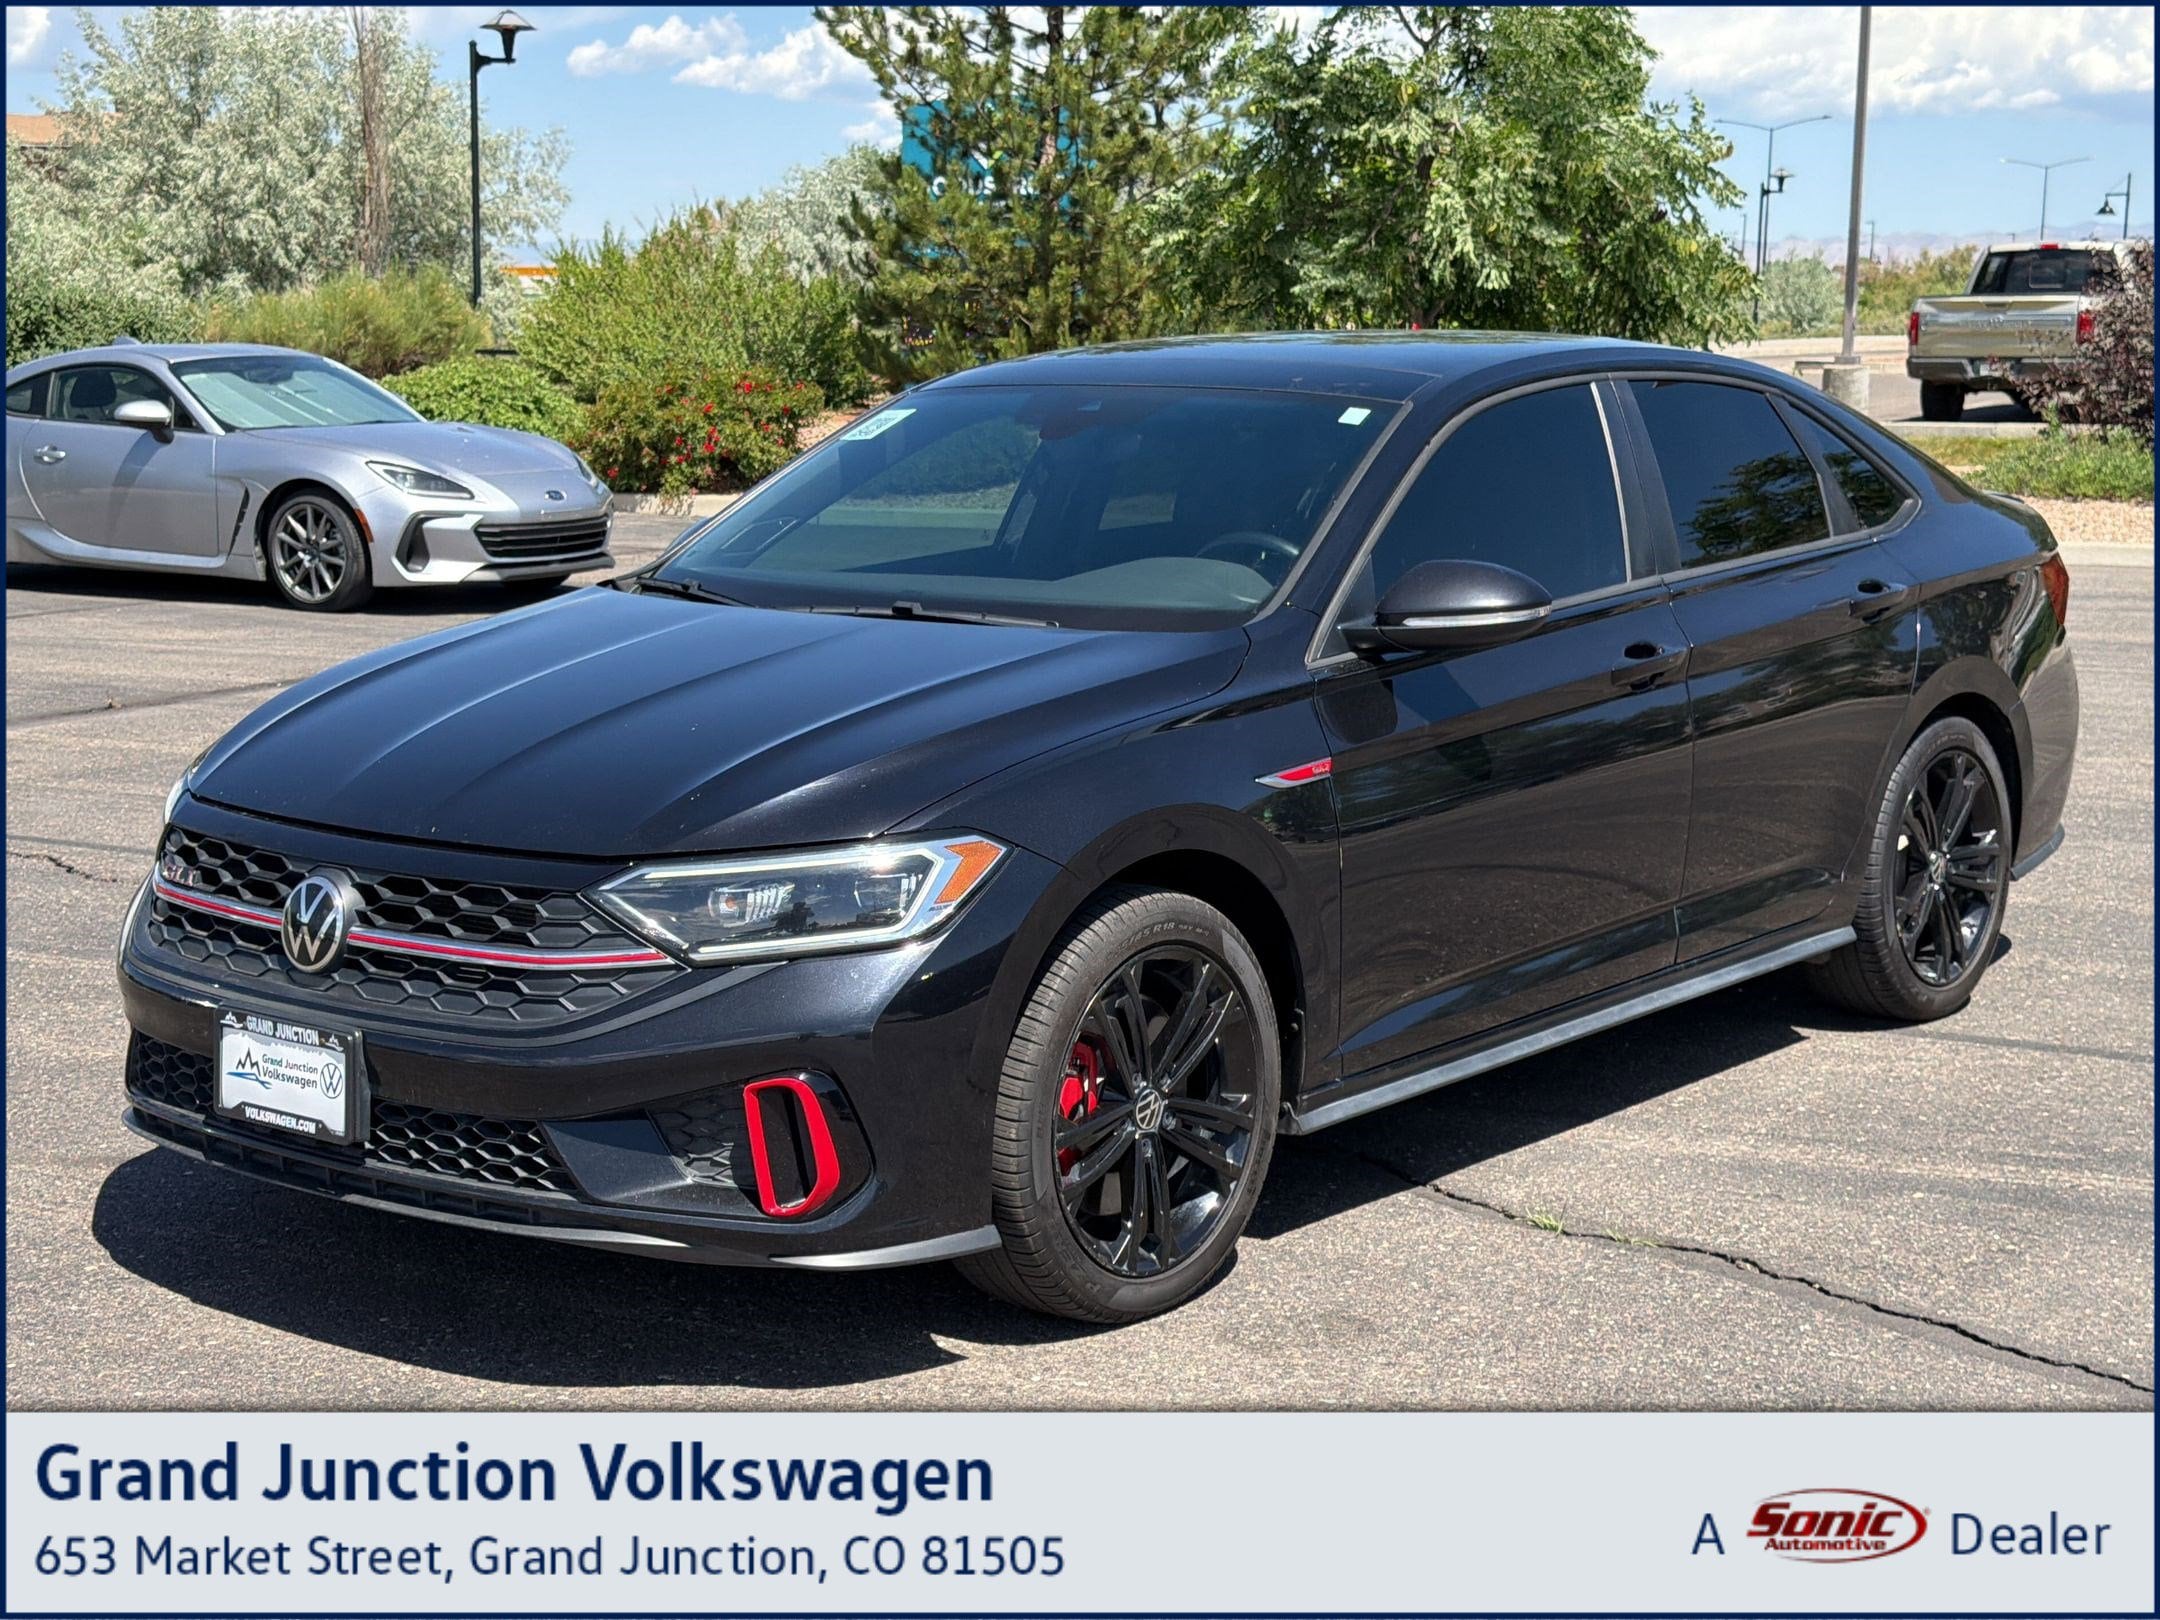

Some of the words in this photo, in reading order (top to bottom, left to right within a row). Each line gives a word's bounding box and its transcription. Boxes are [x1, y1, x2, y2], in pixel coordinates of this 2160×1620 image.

[246, 1015, 273, 1035] GRAND
[276, 1022, 320, 1046] JUNCTION
[262, 1053, 283, 1068] Grand
[284, 1059, 318, 1075] Junction
[262, 1066, 318, 1090] Volkswagen
[244, 1106, 316, 1134] VOLKSWAGEN.COM
